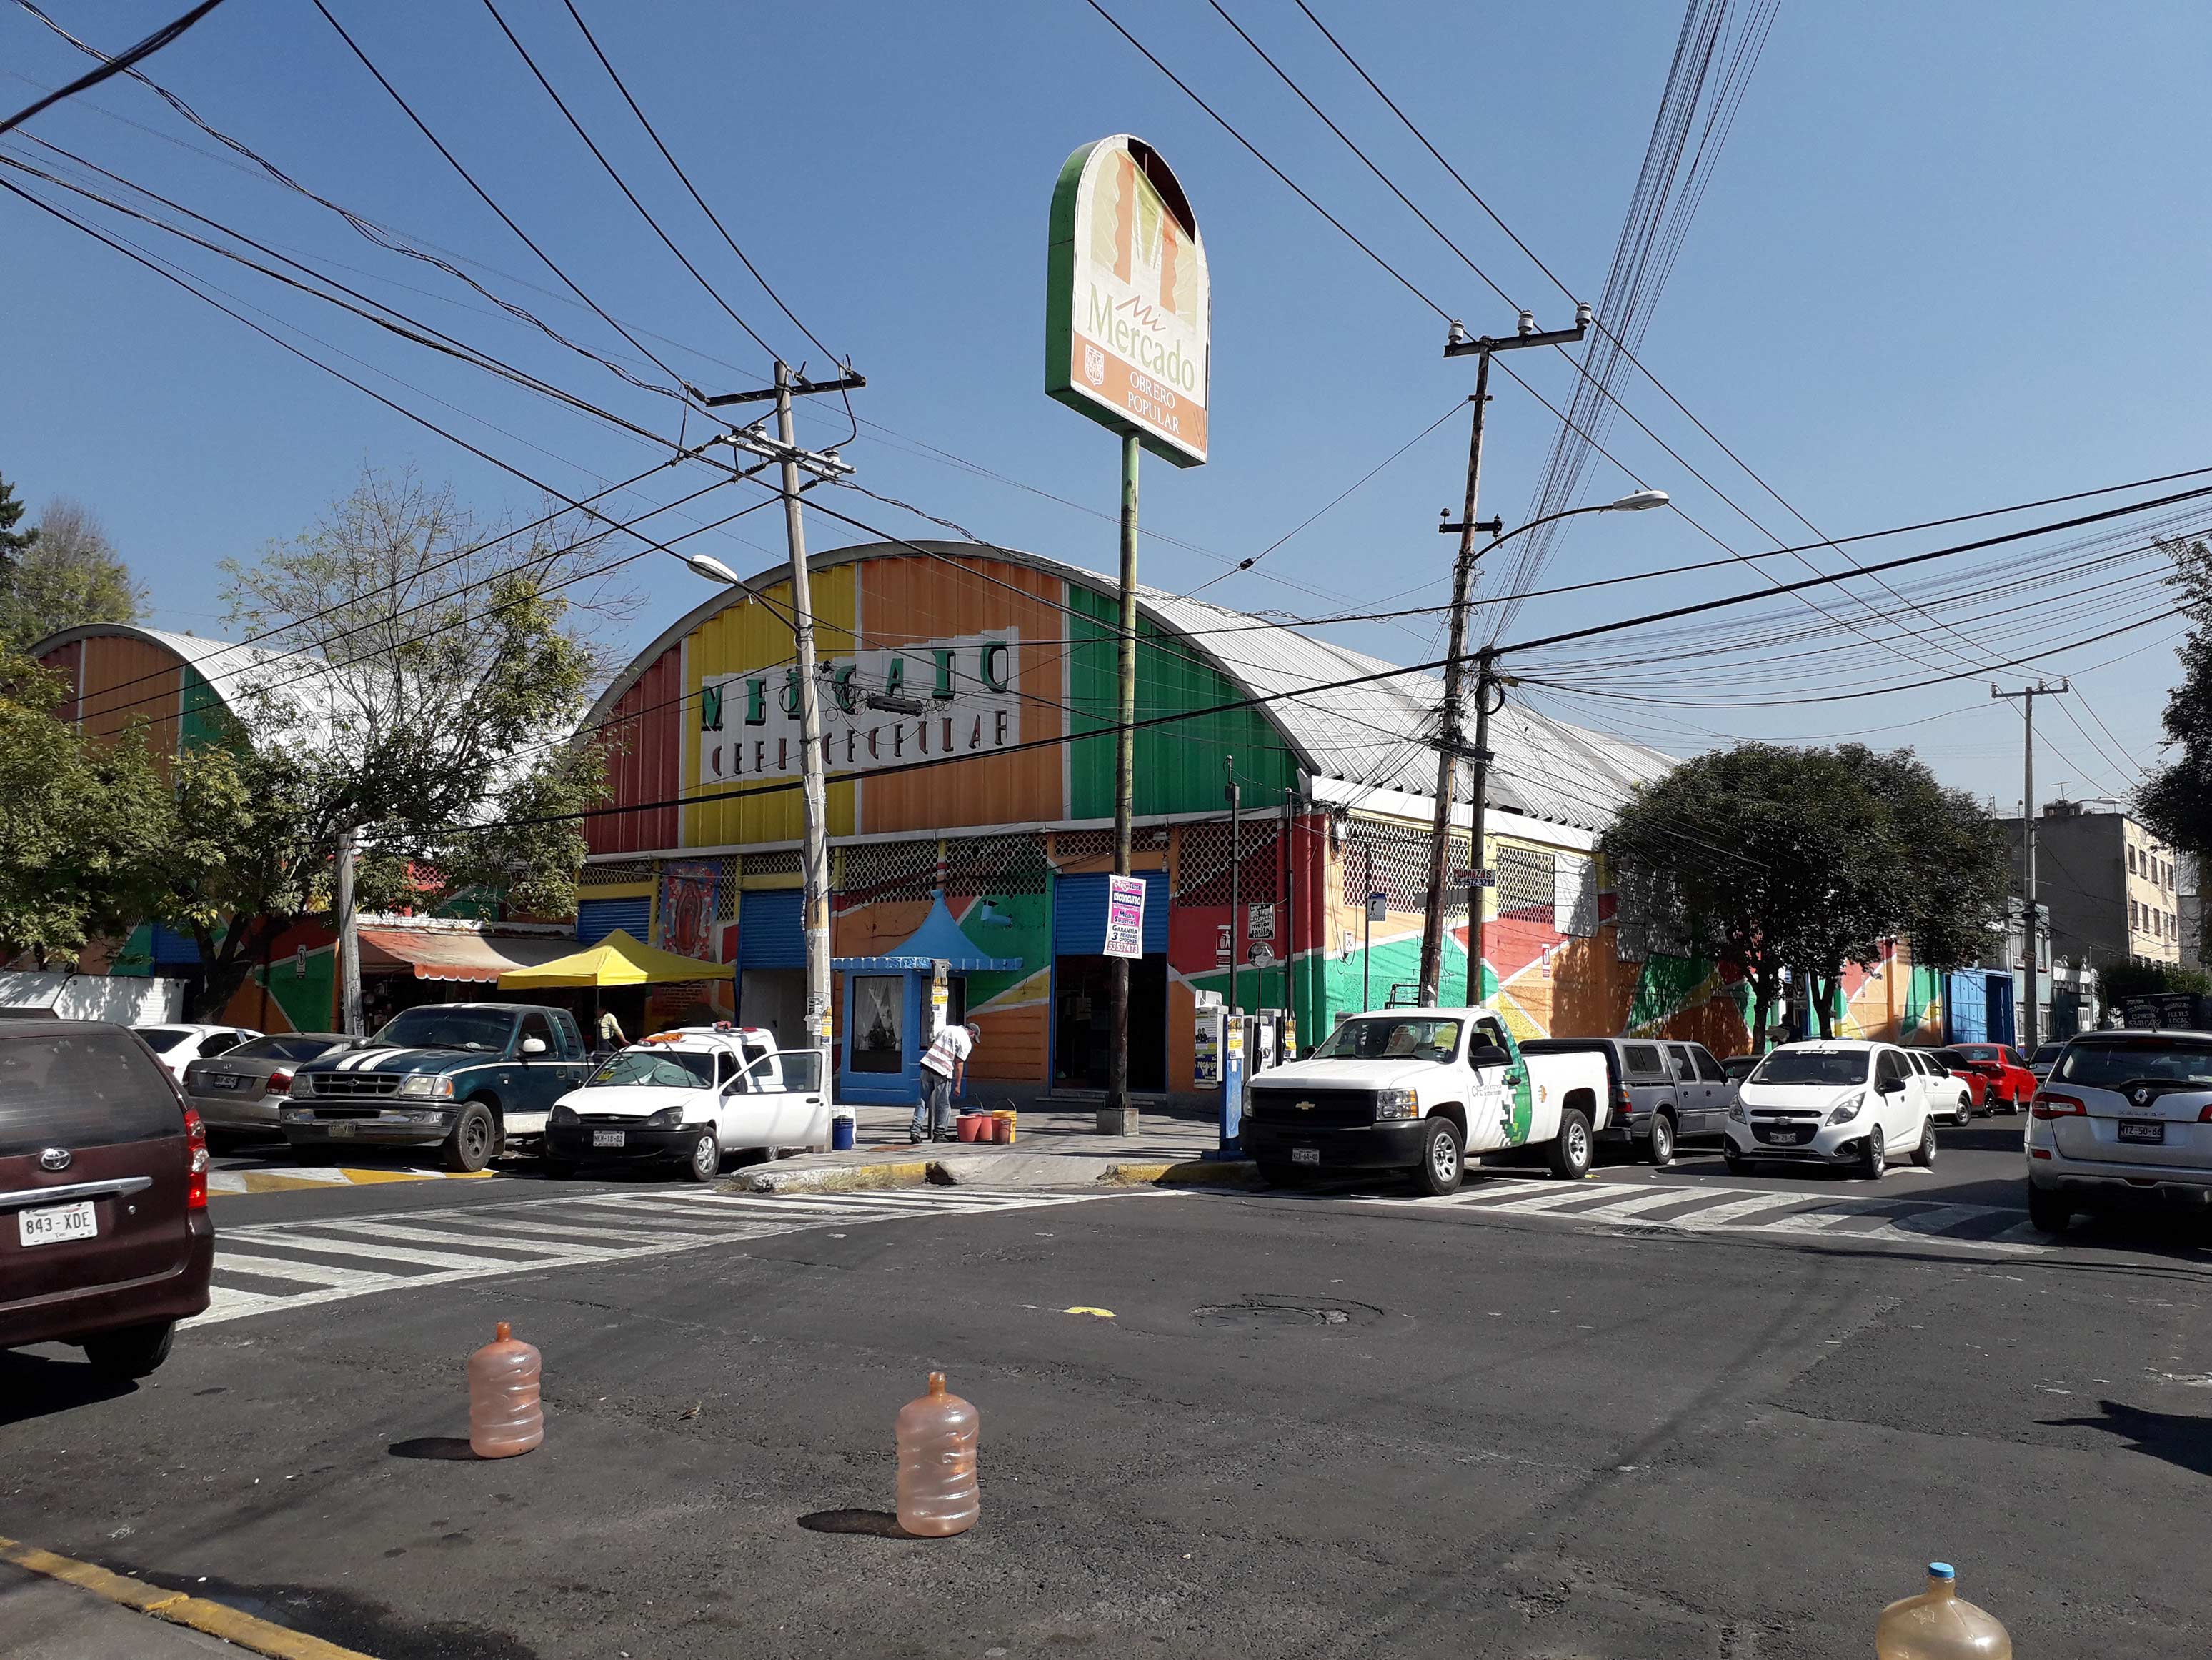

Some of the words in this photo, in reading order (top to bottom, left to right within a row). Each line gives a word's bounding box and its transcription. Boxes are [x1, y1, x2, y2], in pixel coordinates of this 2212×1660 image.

[1115, 294, 1166, 332] Mi
[1087, 282, 1196, 392] Mercado
[1129, 371, 1177, 409] OBRERO
[1127, 390, 1180, 435] POPULAR
[1453, 868, 1492, 879] MUDANZAS
[1119, 910, 1135, 919] Media
[1108, 942, 1138, 953] 53537473
[1111, 932, 1118, 940] 3
[26, 1211, 91, 1234] 843-XDE
